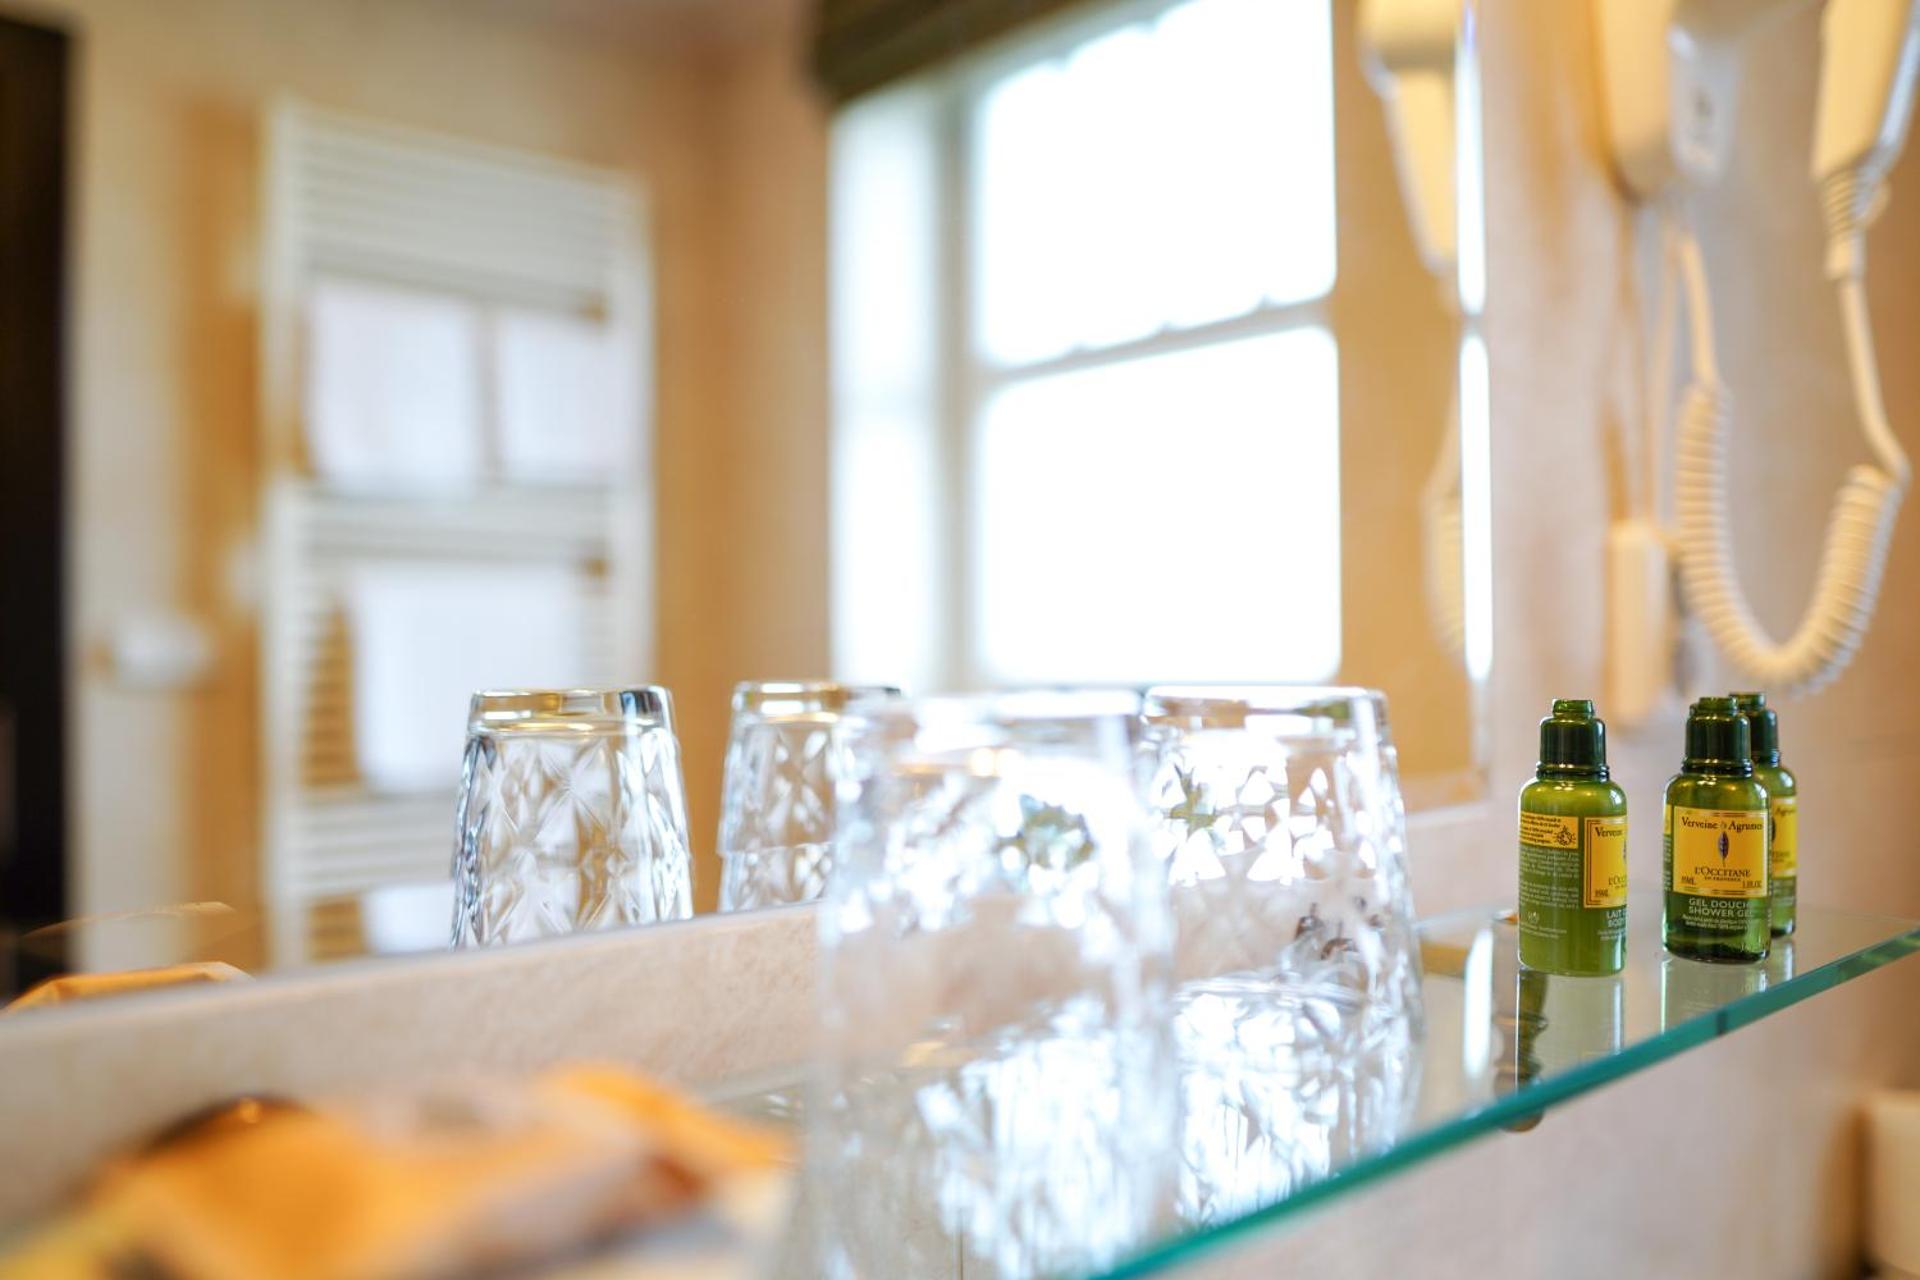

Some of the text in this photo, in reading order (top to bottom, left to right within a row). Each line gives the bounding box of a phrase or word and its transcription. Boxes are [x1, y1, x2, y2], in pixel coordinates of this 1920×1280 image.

[1681, 816, 1718, 829] Verveine
[1689, 897, 1708, 906] GEL
[1689, 906, 1735, 917] SHOWER
